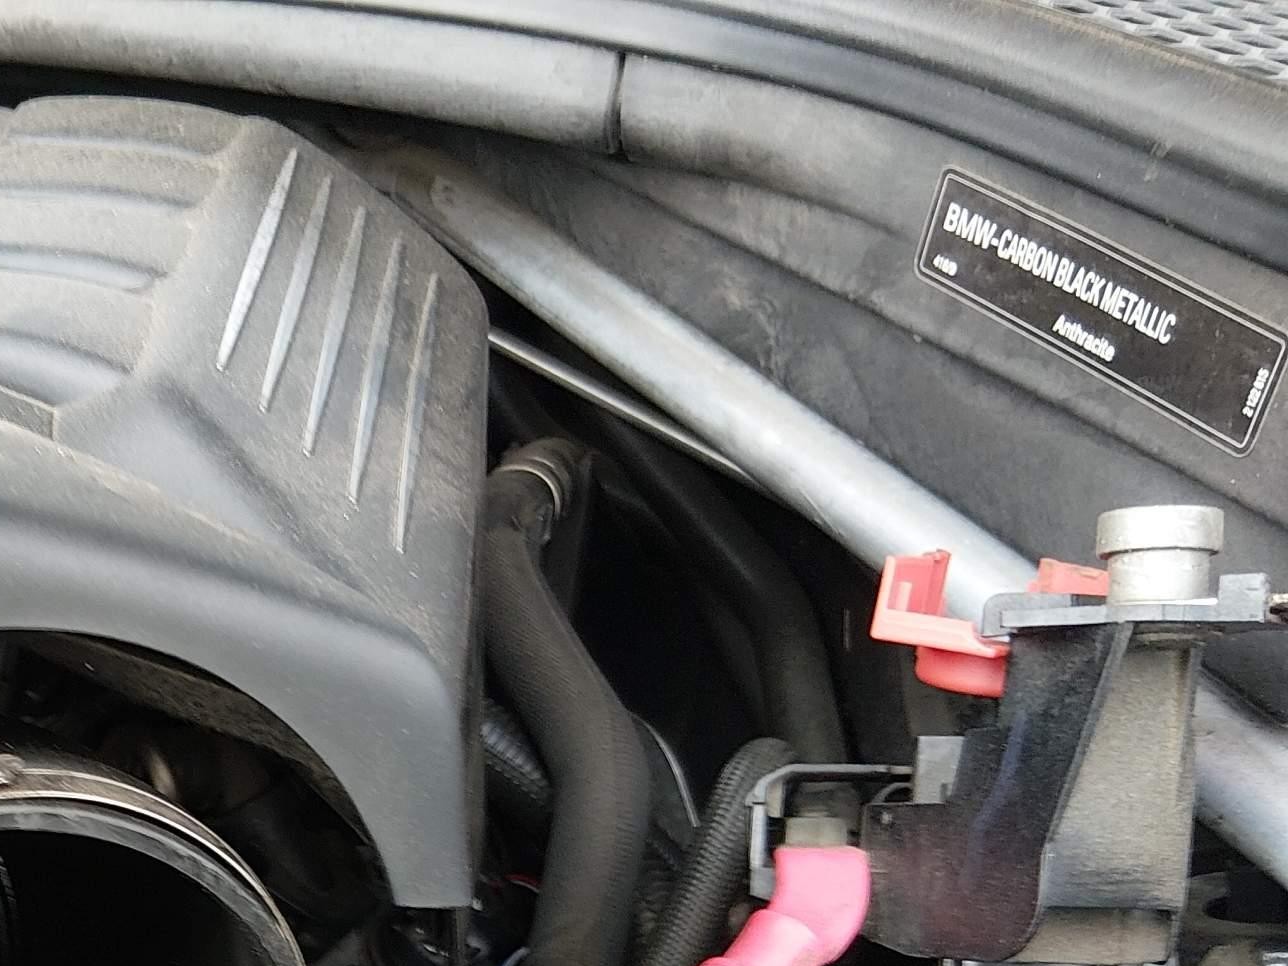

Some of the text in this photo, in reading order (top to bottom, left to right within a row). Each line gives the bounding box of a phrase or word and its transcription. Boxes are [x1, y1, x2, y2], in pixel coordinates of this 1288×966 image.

[943, 202, 1177, 345] BMW-CARBON BLACK METALLIC
[1051, 314, 1116, 363] Anthracite
